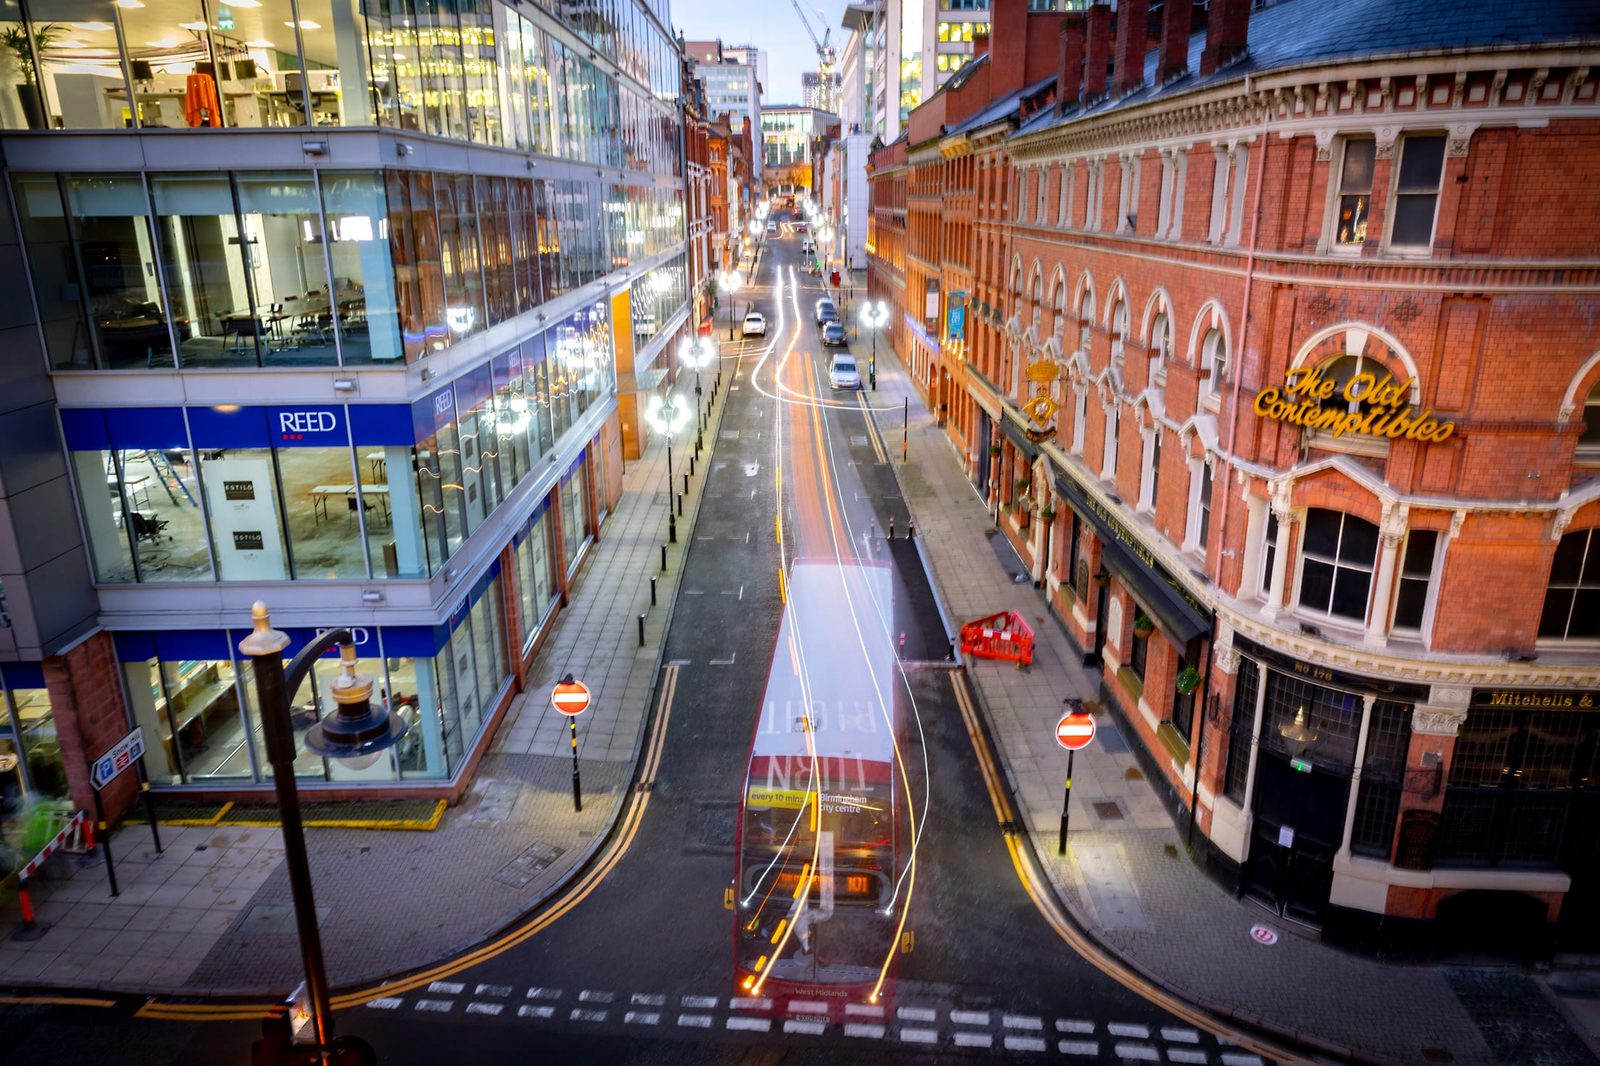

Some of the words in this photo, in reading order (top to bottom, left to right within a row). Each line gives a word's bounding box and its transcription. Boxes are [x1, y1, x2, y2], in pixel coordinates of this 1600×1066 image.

[1284, 366, 1336, 399] The
[1343, 372, 1416, 407] Old
[435, 389, 453, 415] REED
[279, 411, 337, 433] REED
[1253, 386, 1455, 443] Contemptibles
[1489, 691, 1573, 707] Mitchells
[1579, 695, 1593, 707] &
[112, 743, 129, 759] Snow
[130, 731, 141, 745] Hill
[751, 793, 773, 802] every
[776, 793, 784, 801] 10
[785, 794, 804, 802] mins
[834, 804, 861, 814] centre
[847, 876, 868, 893] 101
[794, 987, 814, 996] West
[815, 987, 848, 997] Midlands
